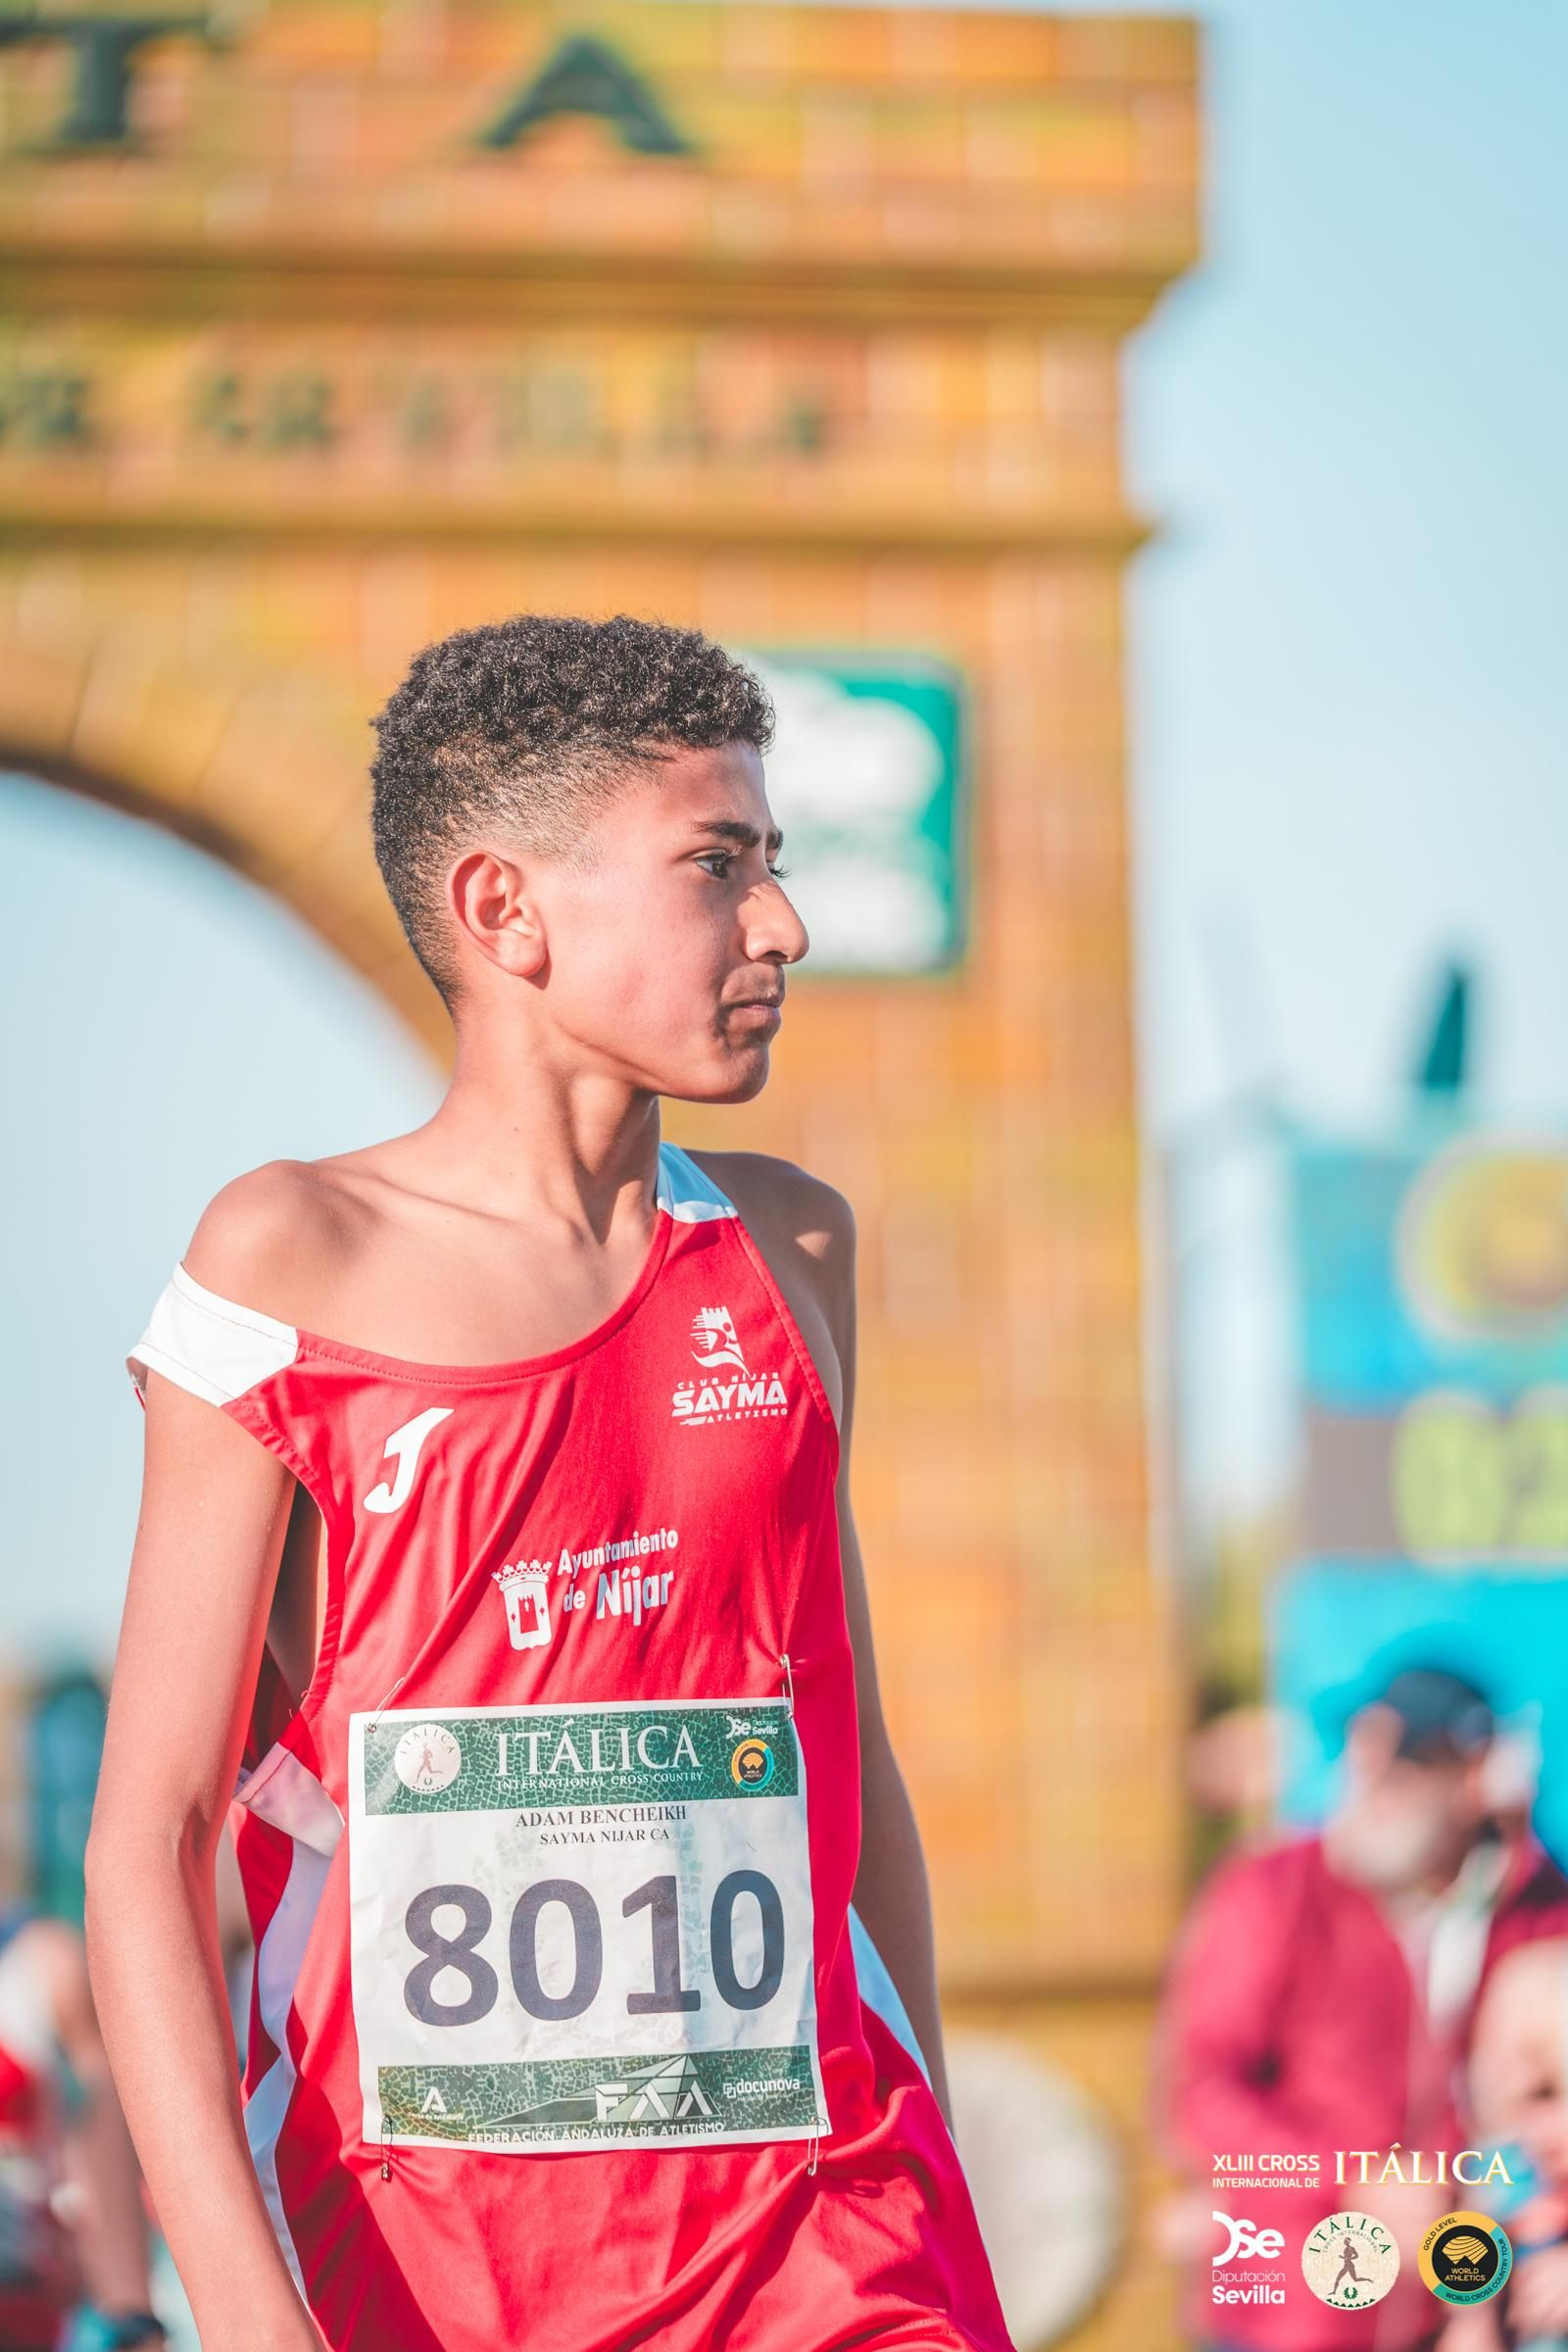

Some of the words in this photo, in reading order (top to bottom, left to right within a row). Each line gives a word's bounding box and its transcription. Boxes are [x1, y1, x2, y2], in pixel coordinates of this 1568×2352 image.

[677, 1378, 718, 1390] CLUB
[671, 1380, 788, 1417] SAYMA
[707, 1408, 788, 1423] ATLETISMO
[557, 1526, 679, 1579] Ayuntamiento
[563, 1584, 586, 1613] de
[596, 1566, 675, 1627] Níjar
[753, 1726, 779, 1735] Sevilla
[495, 1718, 705, 1777] ITÁLICA
[497, 1776, 605, 1789] INTERNATIONAL
[612, 1774, 649, 1787] CROSS
[654, 1771, 705, 1783] COUNTRY
[515, 1811, 573, 1828] ADAM
[580, 1805, 687, 1825] BENCHEIKH
[540, 1830, 595, 1845] SAYMA
[601, 1829, 646, 1842] NIJAR
[651, 1828, 670, 1840] CA
[404, 1869, 785, 2028] 8010
[737, 2078, 801, 2094] docunova
[468, 2127, 555, 2143] FEDERACIÓN
[563, 2126, 634, 2141] ANDALUZA
[640, 2126, 656, 2137] DE
[661, 2122, 724, 2136] ATLETISMO
